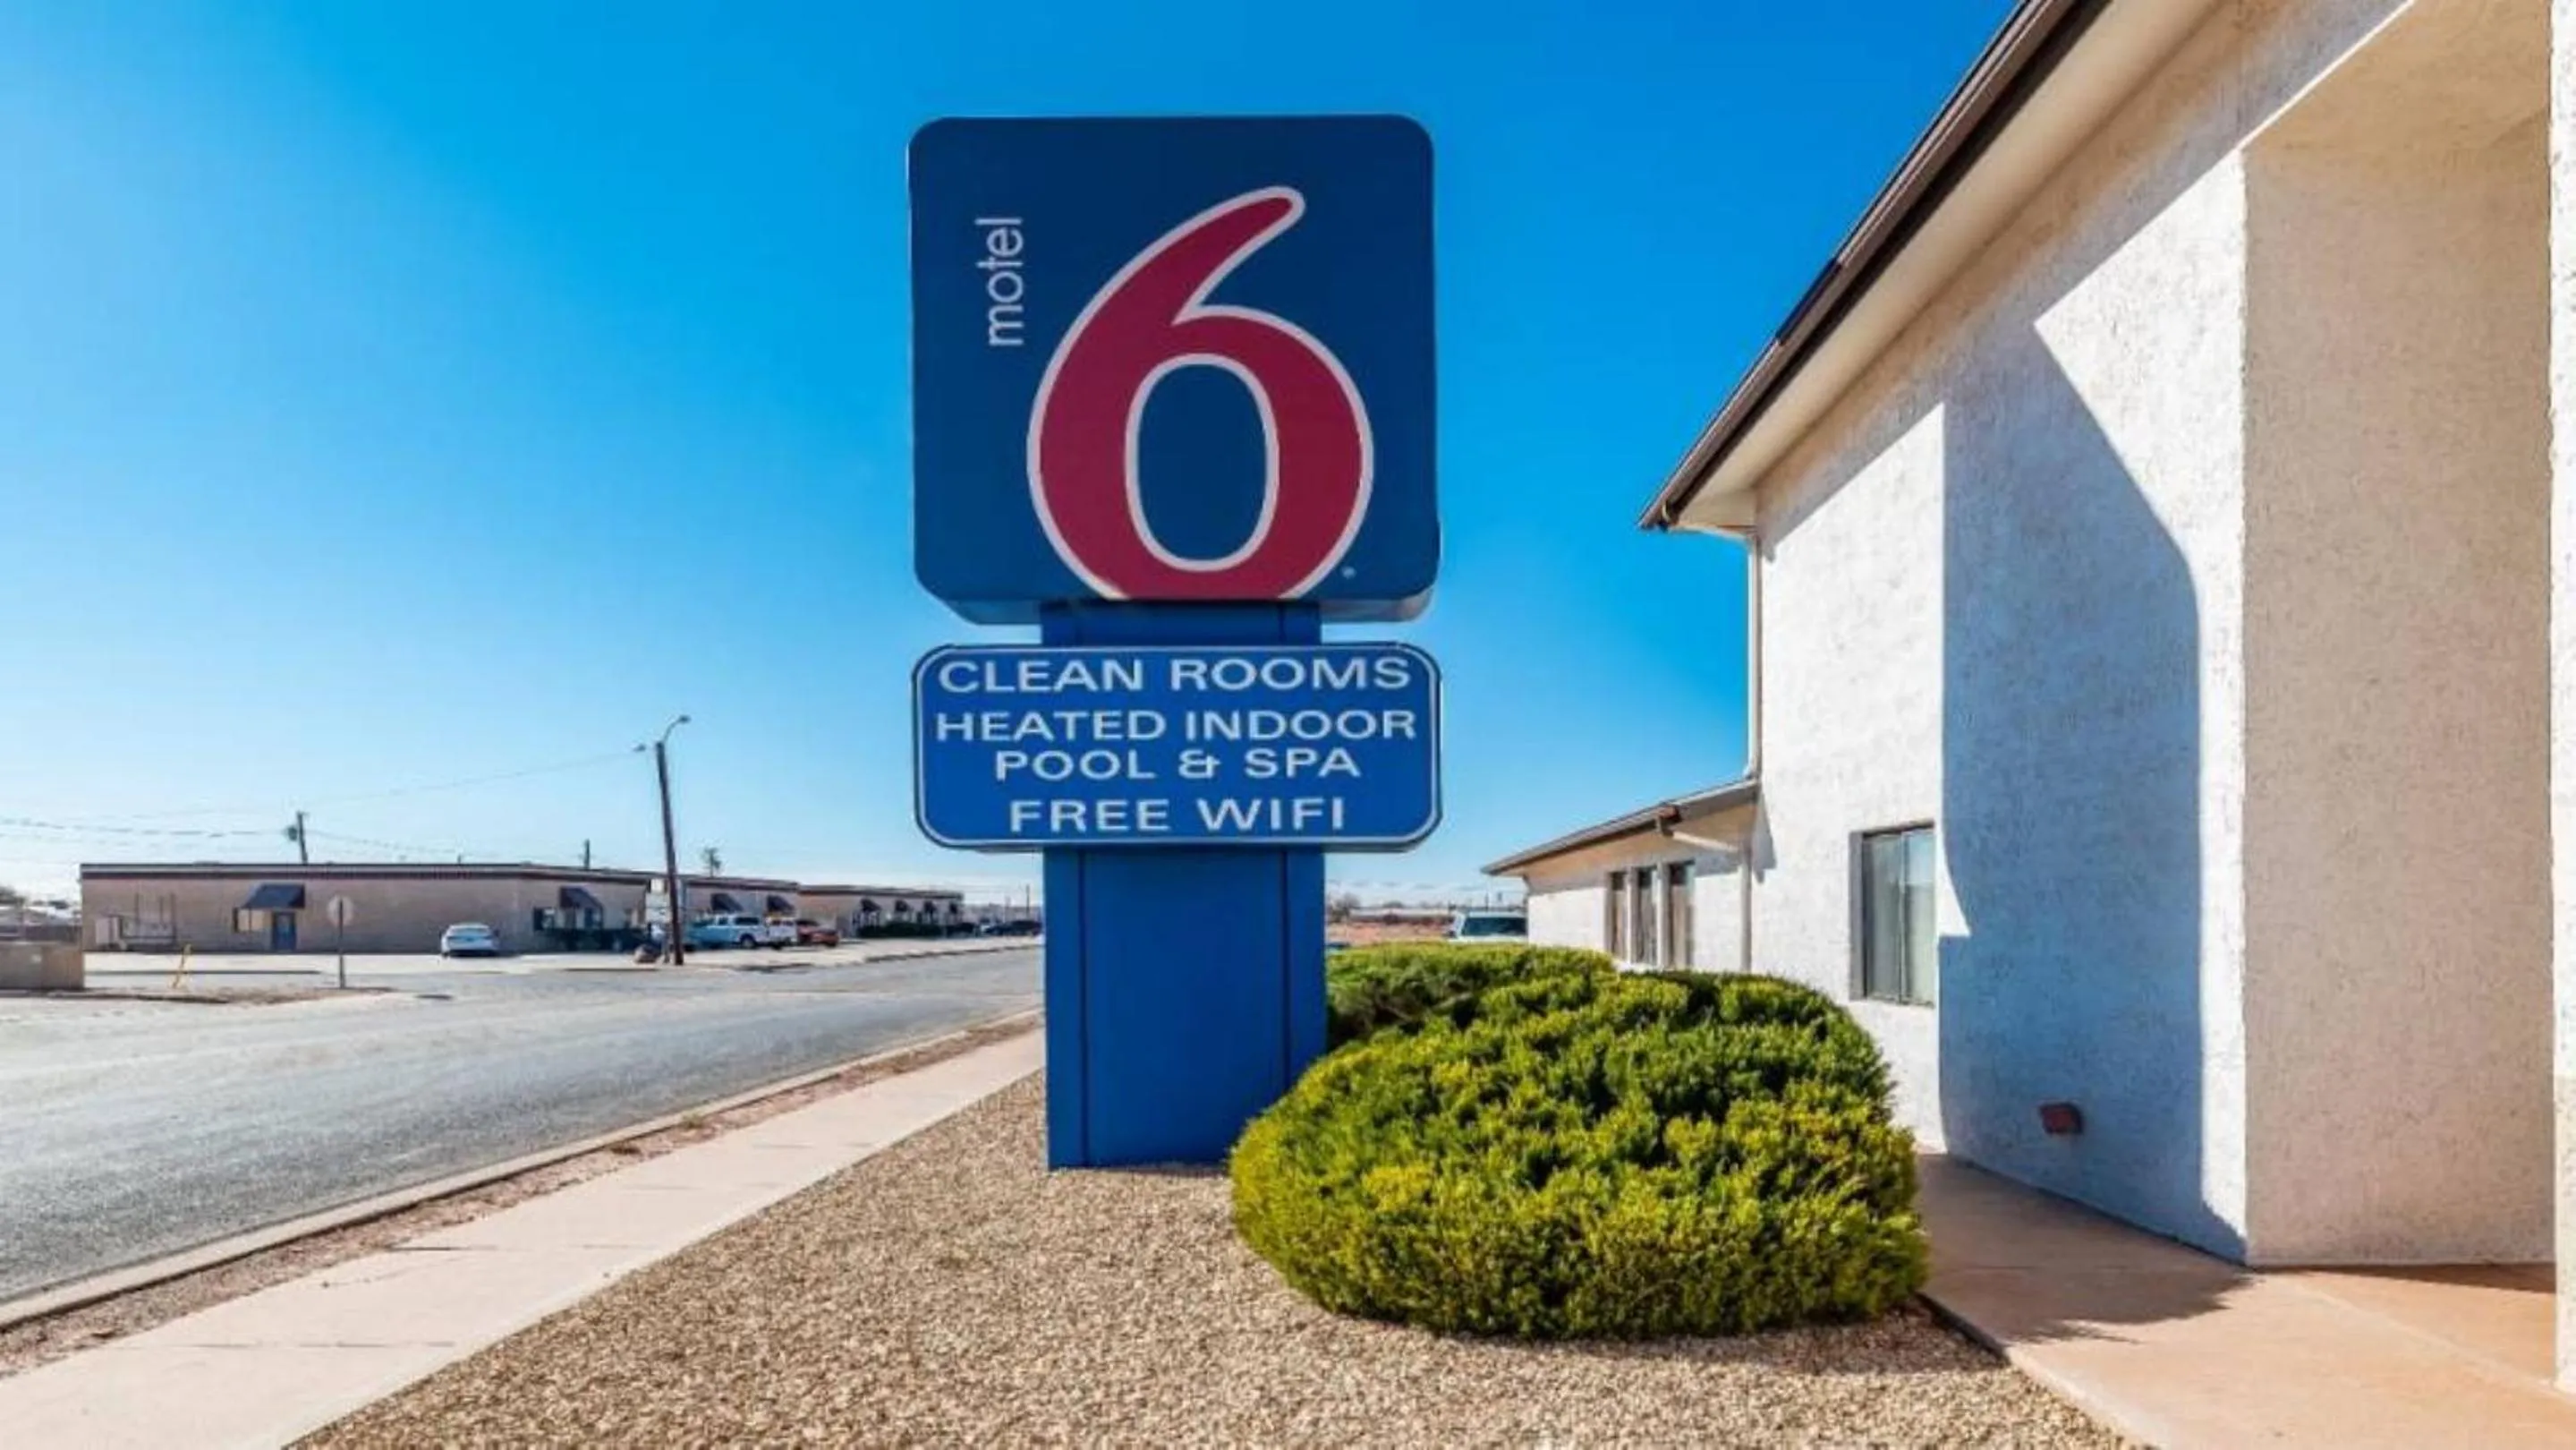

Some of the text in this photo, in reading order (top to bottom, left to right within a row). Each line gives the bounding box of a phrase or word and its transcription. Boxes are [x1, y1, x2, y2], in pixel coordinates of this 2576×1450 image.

[974, 217, 1024, 346] motel
[1026, 185, 1373, 600] 6
[938, 657, 1411, 694] CLEAN ROOMS
[935, 710, 1416, 741] HEATED INDOOR
[995, 747, 1361, 780] POOL & SPA
[1009, 797, 1344, 833] FREE WIFI
